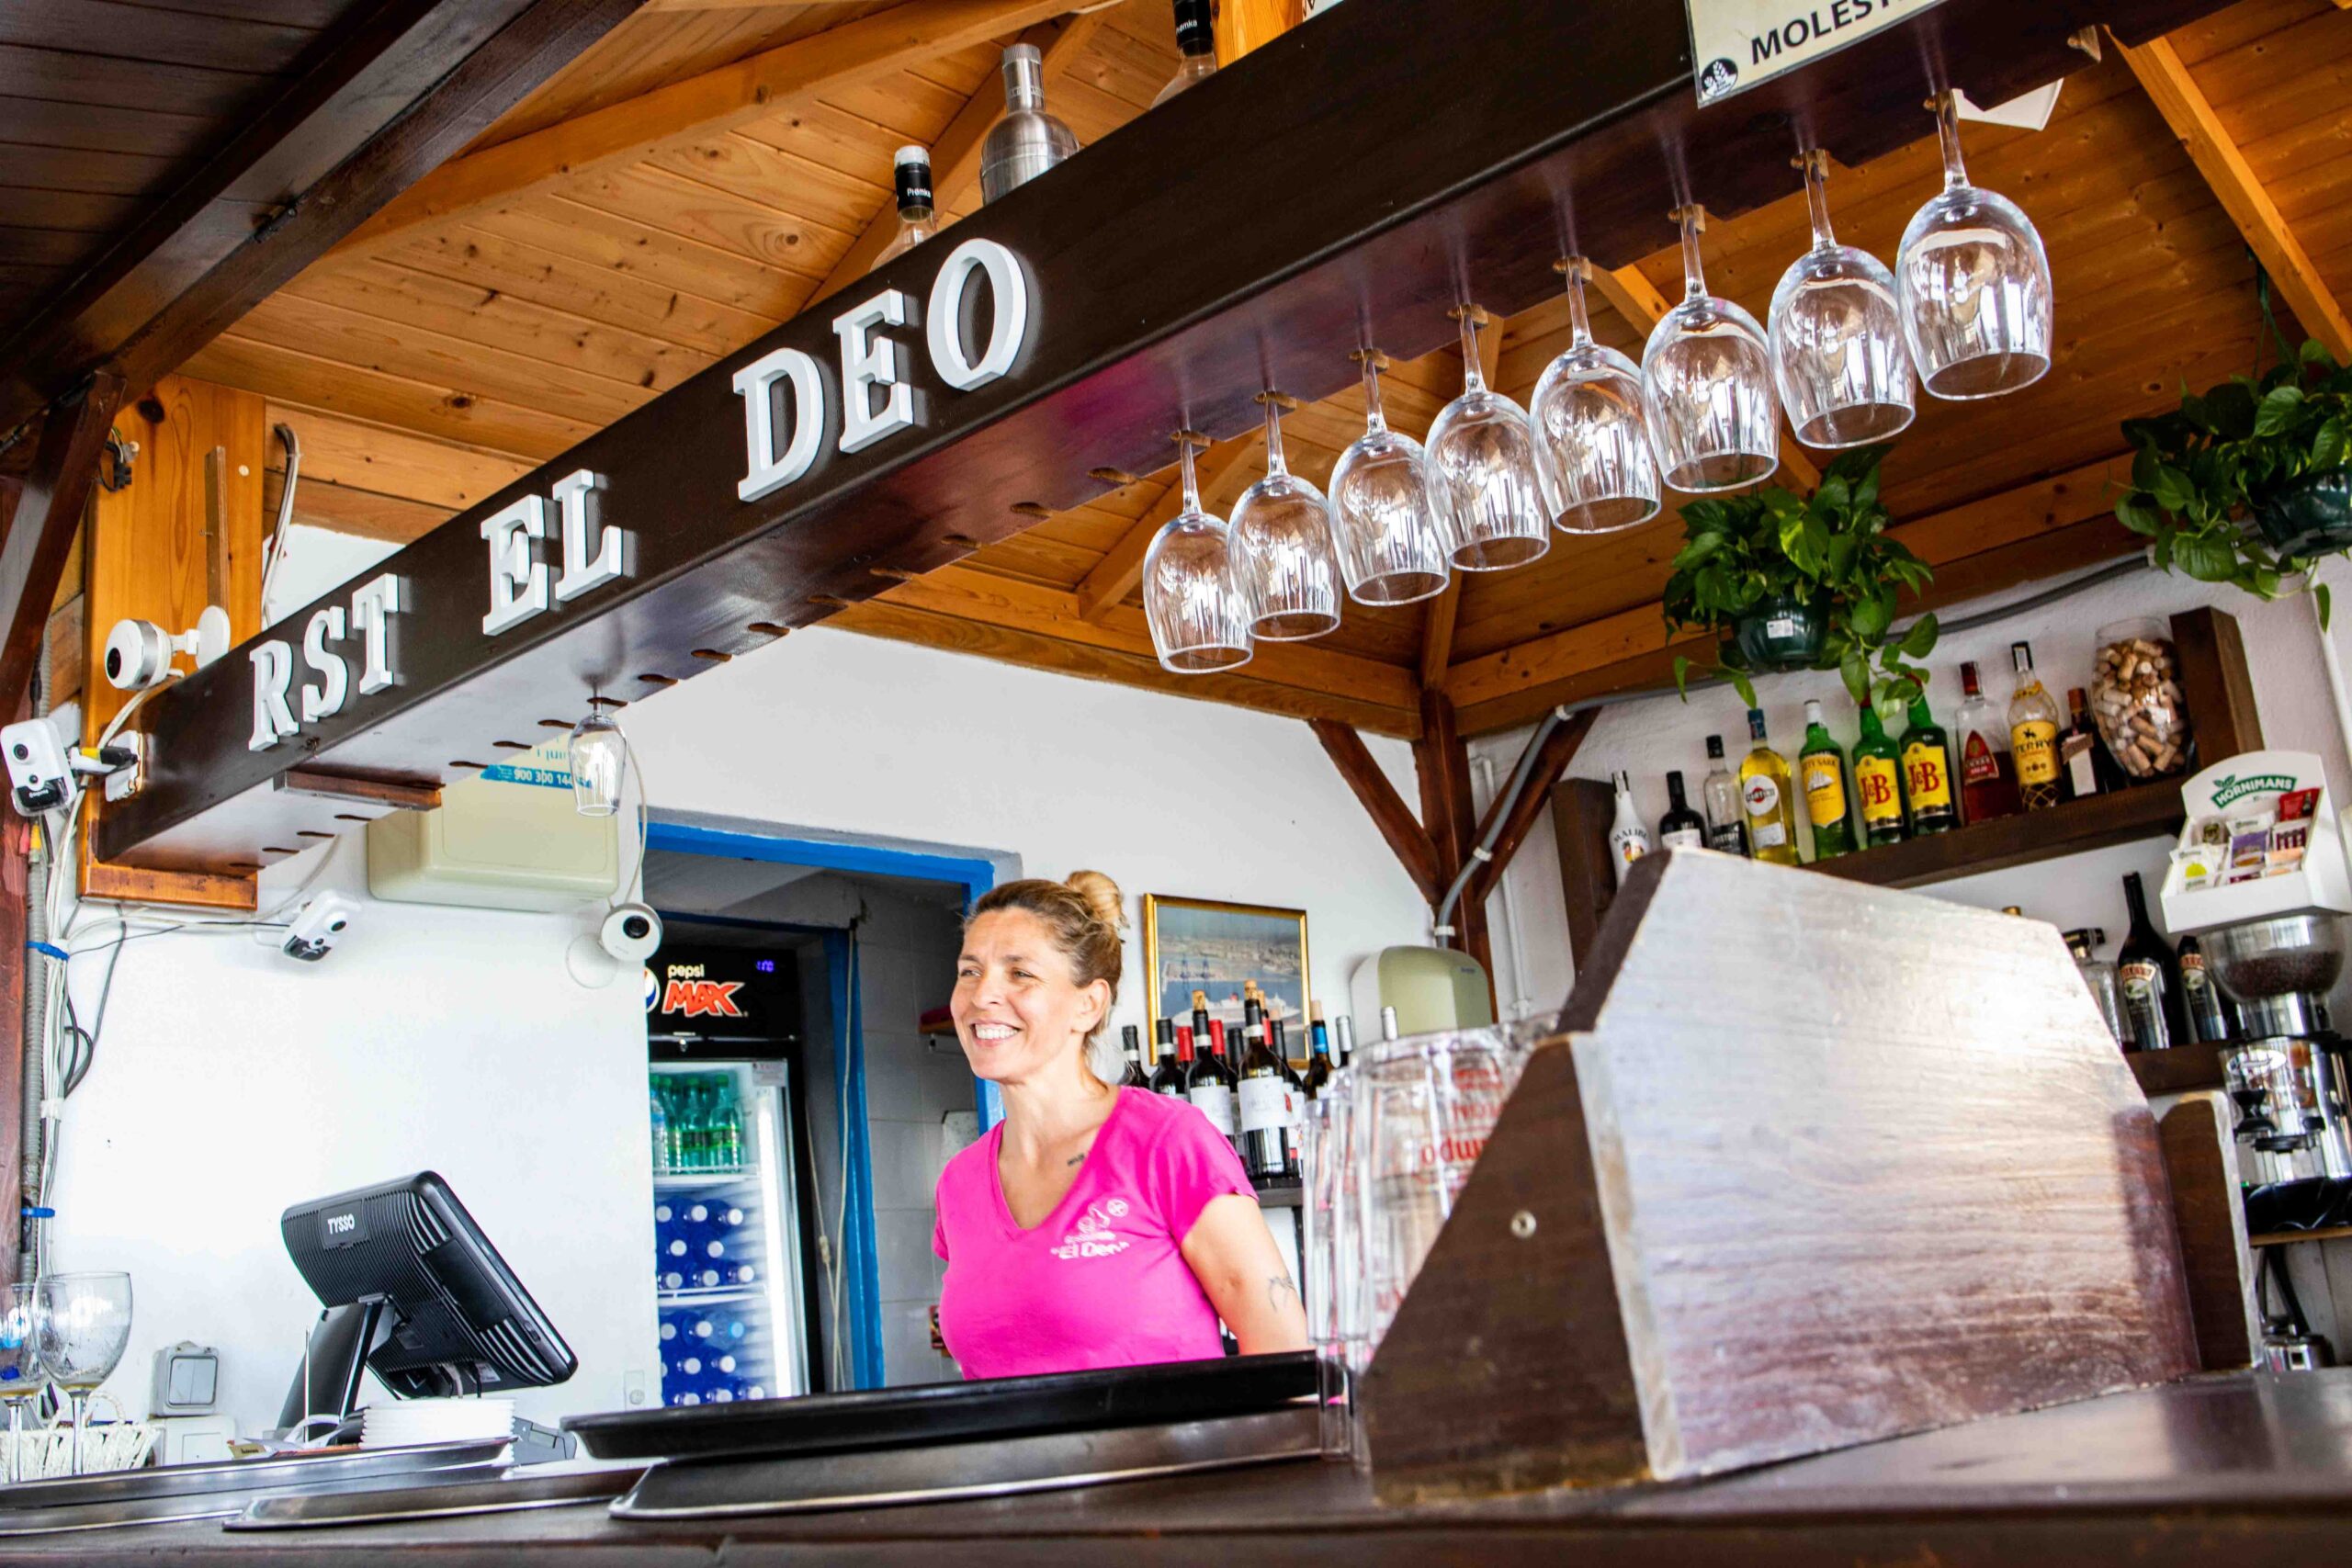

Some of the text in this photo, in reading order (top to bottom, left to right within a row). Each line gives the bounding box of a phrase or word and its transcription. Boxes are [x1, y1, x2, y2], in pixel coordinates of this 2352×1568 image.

[248, 238, 1026, 751] RST EL DEO
[514, 769, 532, 782] 900
[2216, 777, 2293, 806] HORNIMANS
[667, 964, 705, 979] pepsi
[662, 979, 745, 1018] MAX
[327, 1213, 356, 1235] TYSSO
